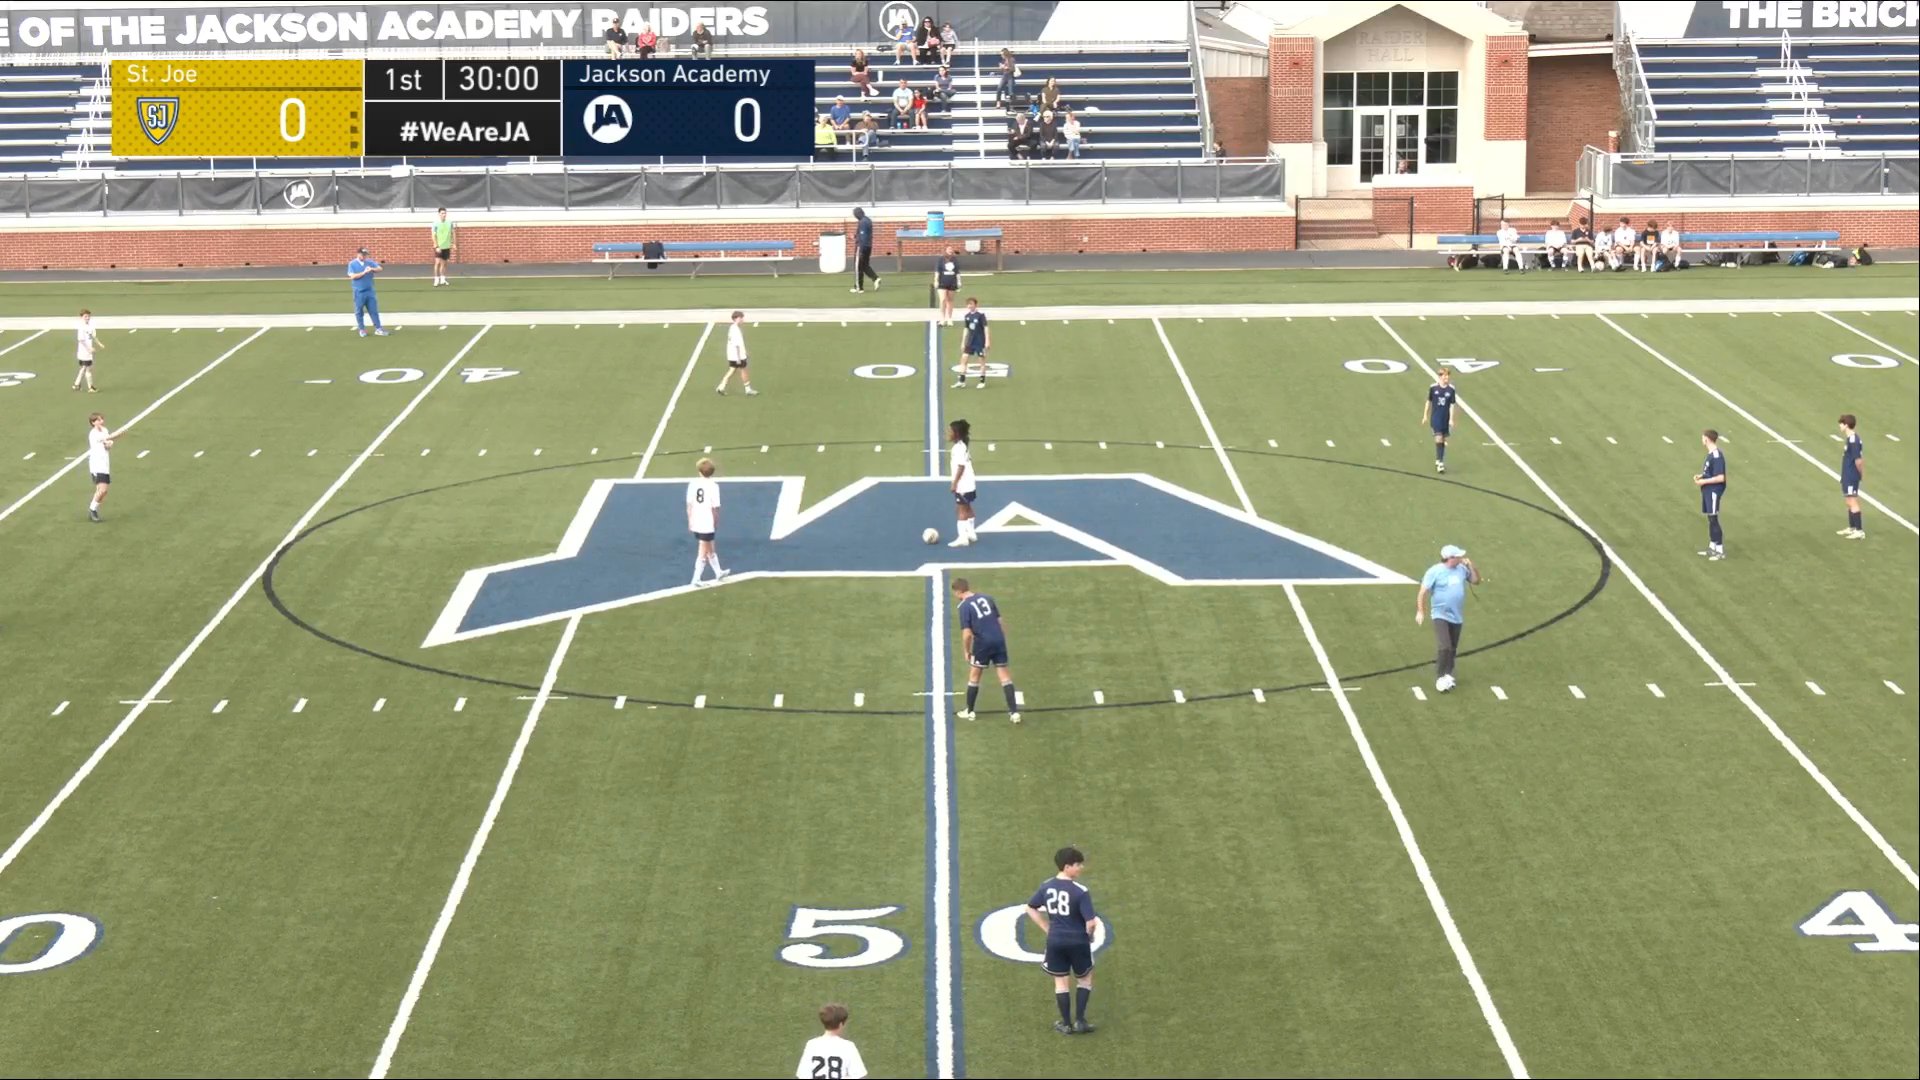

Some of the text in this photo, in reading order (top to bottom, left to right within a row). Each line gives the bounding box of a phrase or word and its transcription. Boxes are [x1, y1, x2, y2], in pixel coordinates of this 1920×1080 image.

[1722, 1, 1802, 28] THE
[18, 16, 75, 47] OF
[83, 15, 166, 46] THE
[175, 10, 367, 45] JACKSON
[376, 8, 582, 41] ACADEMY
[591, 6, 769, 38] RAIDERS
[1359, 31, 1425, 45] RAIDER
[1367, 48, 1415, 62] HALL
[696, 488, 704, 504] 8
[970, 597, 992, 619] 13
[1046, 888, 1070, 916] 28
[811, 1055, 843, 1079] 28
